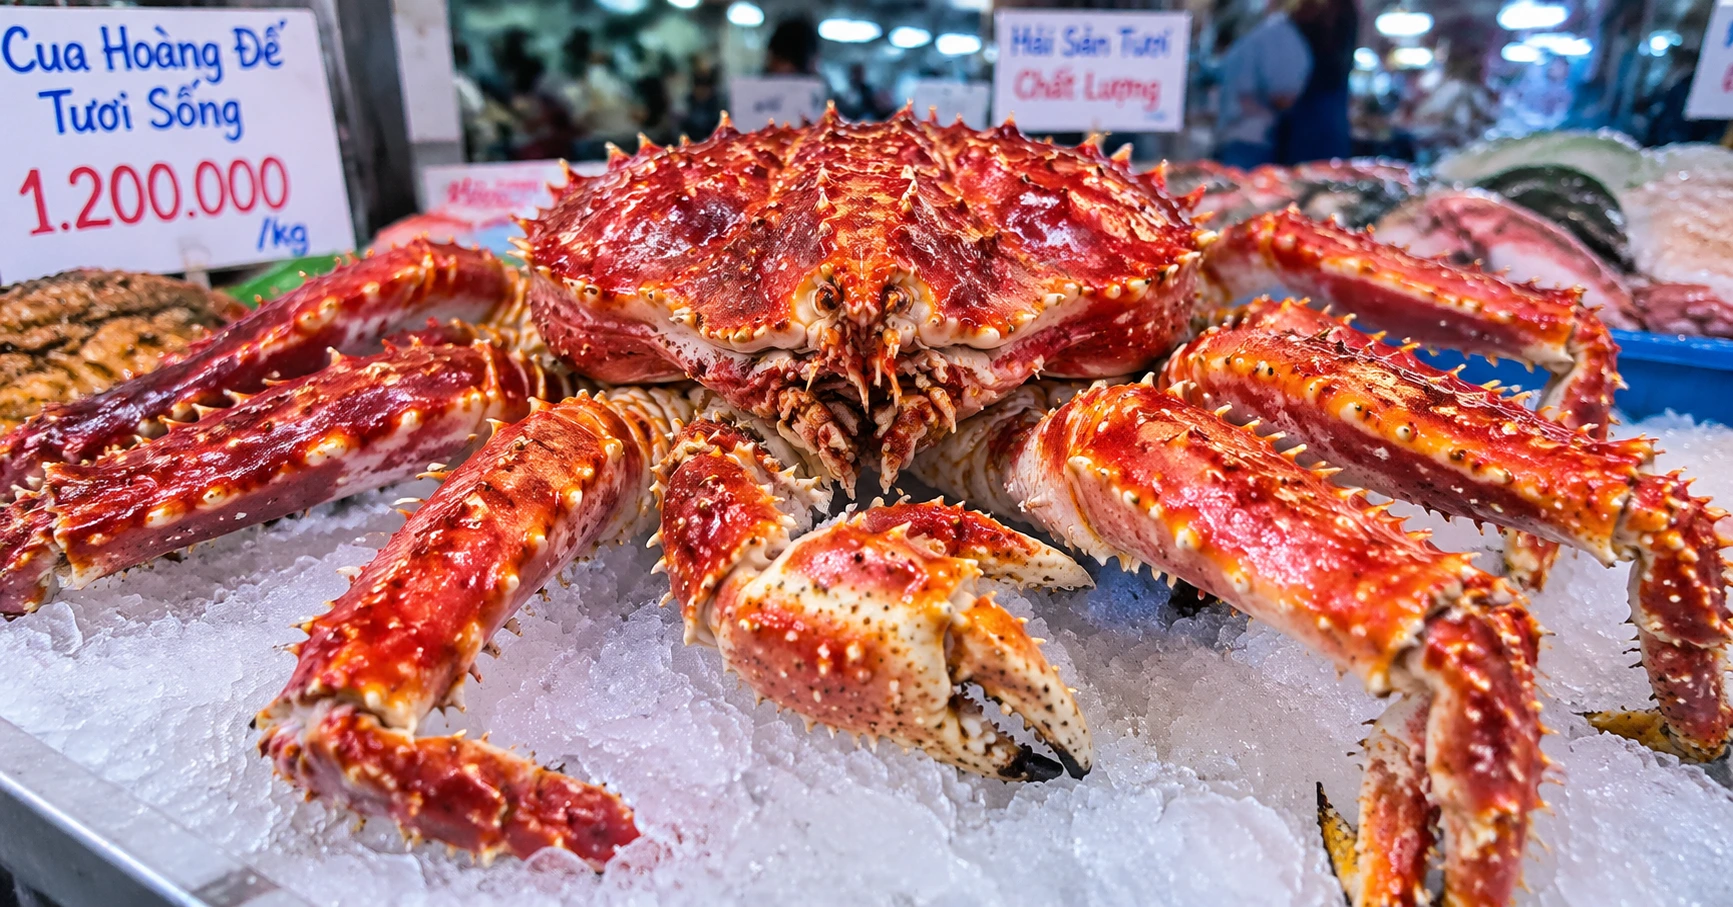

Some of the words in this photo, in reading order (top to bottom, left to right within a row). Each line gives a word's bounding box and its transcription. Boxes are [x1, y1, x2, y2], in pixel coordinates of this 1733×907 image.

[2, 25, 90, 72] Cua
[100, 25, 223, 84] Hoàng
[233, 19, 288, 69] Đế
[38, 88, 132, 135] Tươi
[147, 79, 243, 142] Sống
[19, 156, 289, 235] 1.200.000
[257, 217, 310, 257] /kg
